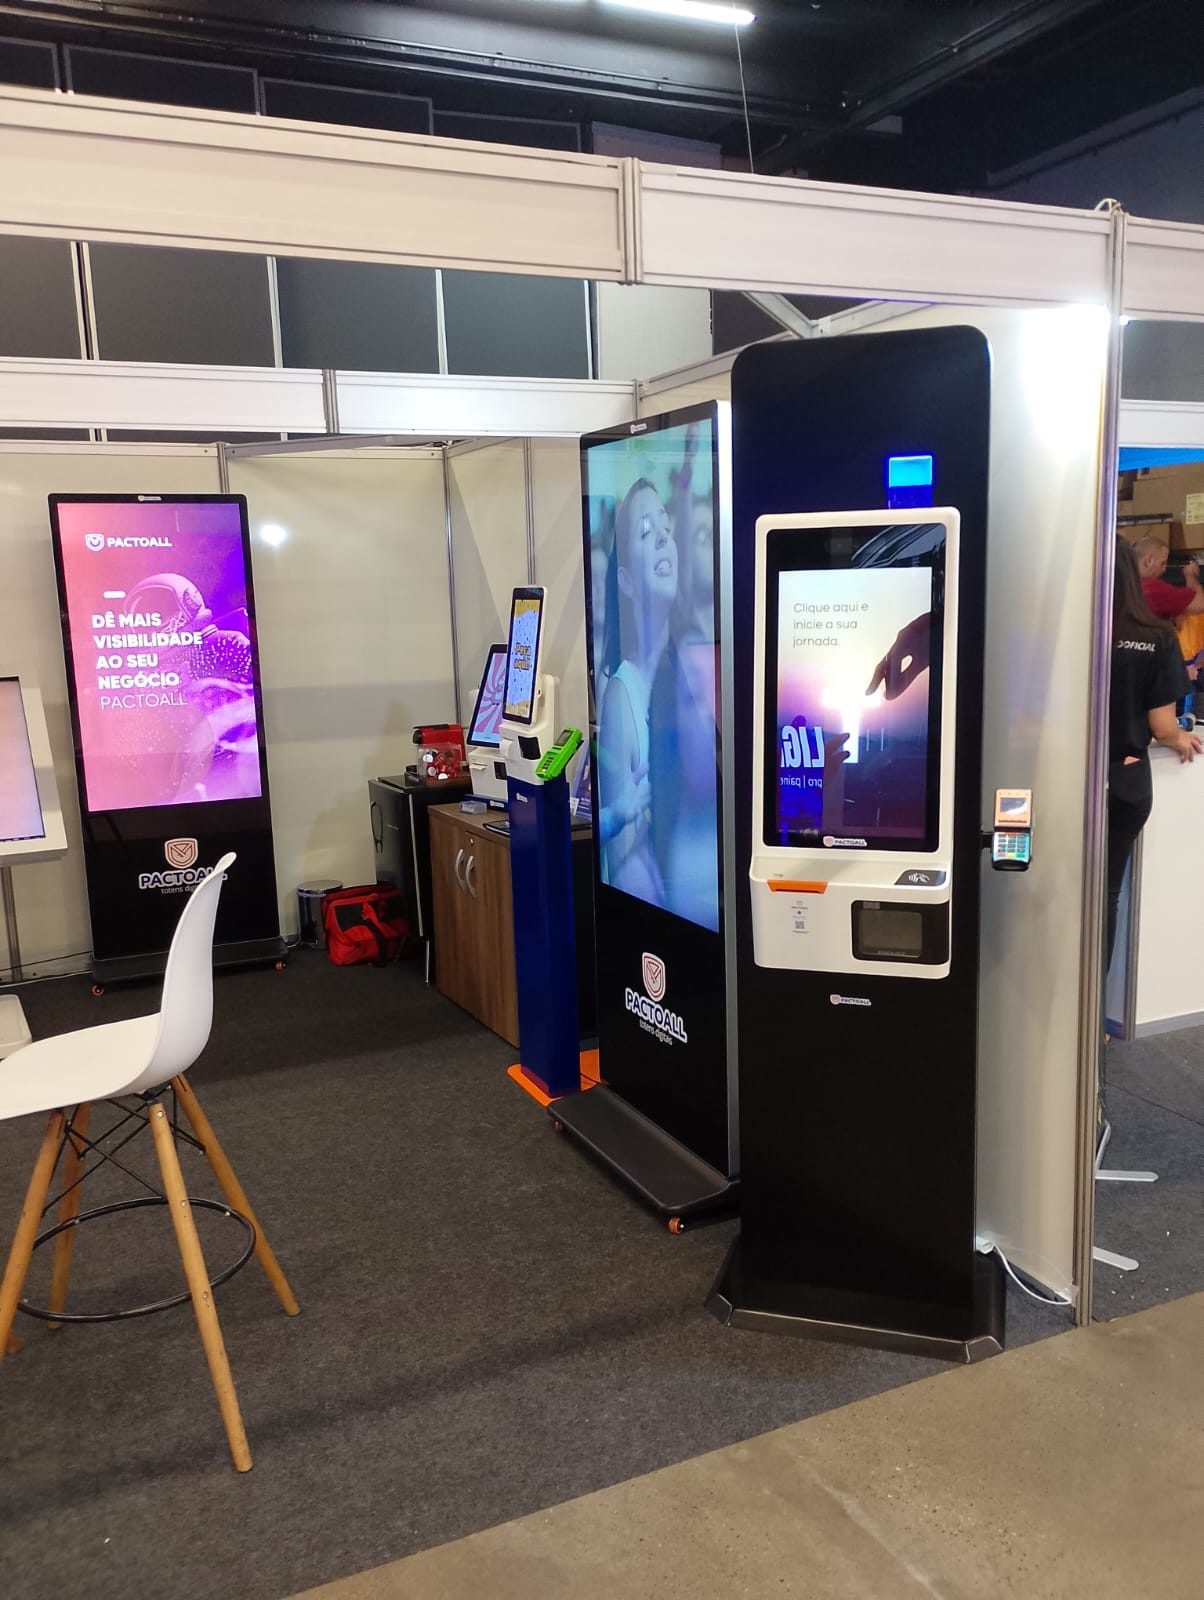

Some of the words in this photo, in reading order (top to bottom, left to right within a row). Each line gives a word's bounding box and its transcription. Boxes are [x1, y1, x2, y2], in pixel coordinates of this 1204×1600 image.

[107, 537, 172, 547] PACTOALL
[794, 603, 830, 615] Clique
[832, 602, 859, 614] aqui
[861, 603, 869, 612] e
[92, 611, 116, 628] DÊ
[119, 613, 162, 627] MAIS
[794, 619, 823, 630] inicie
[826, 621, 834, 629] a
[836, 620, 858, 629] sua
[94, 632, 203, 648] VISIBILIDADE
[96, 655, 122, 669] AO
[126, 653, 158, 667] SEU
[98, 672, 180, 689] NEGÓCIO
[100, 693, 188, 710] PACTOALL
[139, 866, 228, 889] PACTOA
[161, 886, 183, 894] totens
[626, 987, 687, 1043] PACTOALL
